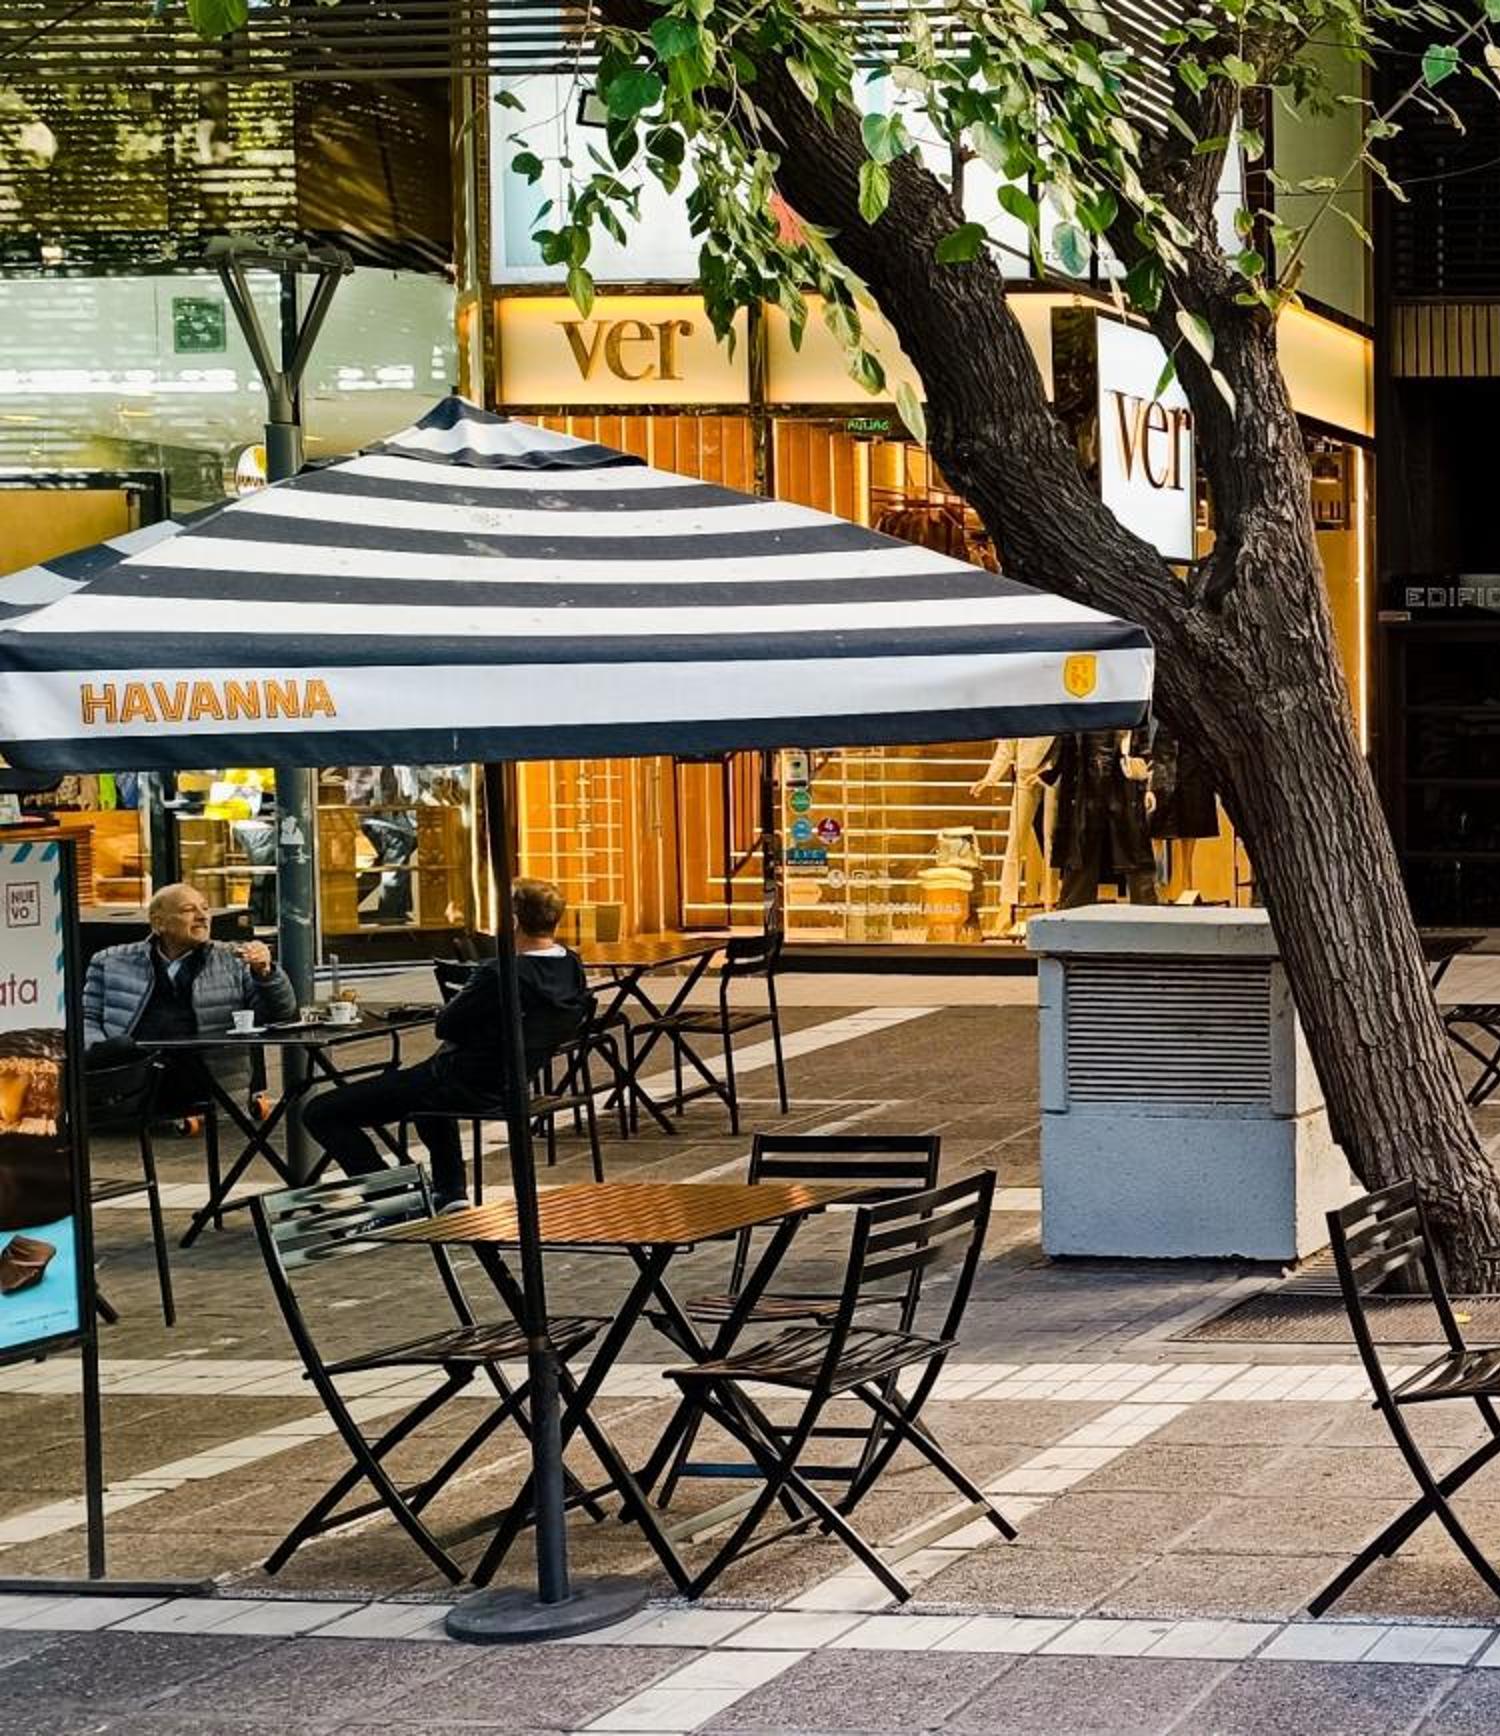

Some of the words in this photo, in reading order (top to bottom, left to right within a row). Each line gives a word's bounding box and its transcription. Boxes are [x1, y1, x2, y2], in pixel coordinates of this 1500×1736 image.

[554, 319, 694, 382] ver
[1103, 389, 1192, 491] ver
[80, 679, 337, 724] HAVANNA
[11, 889, 34, 903] NUE
[11, 906, 30, 919] VO
